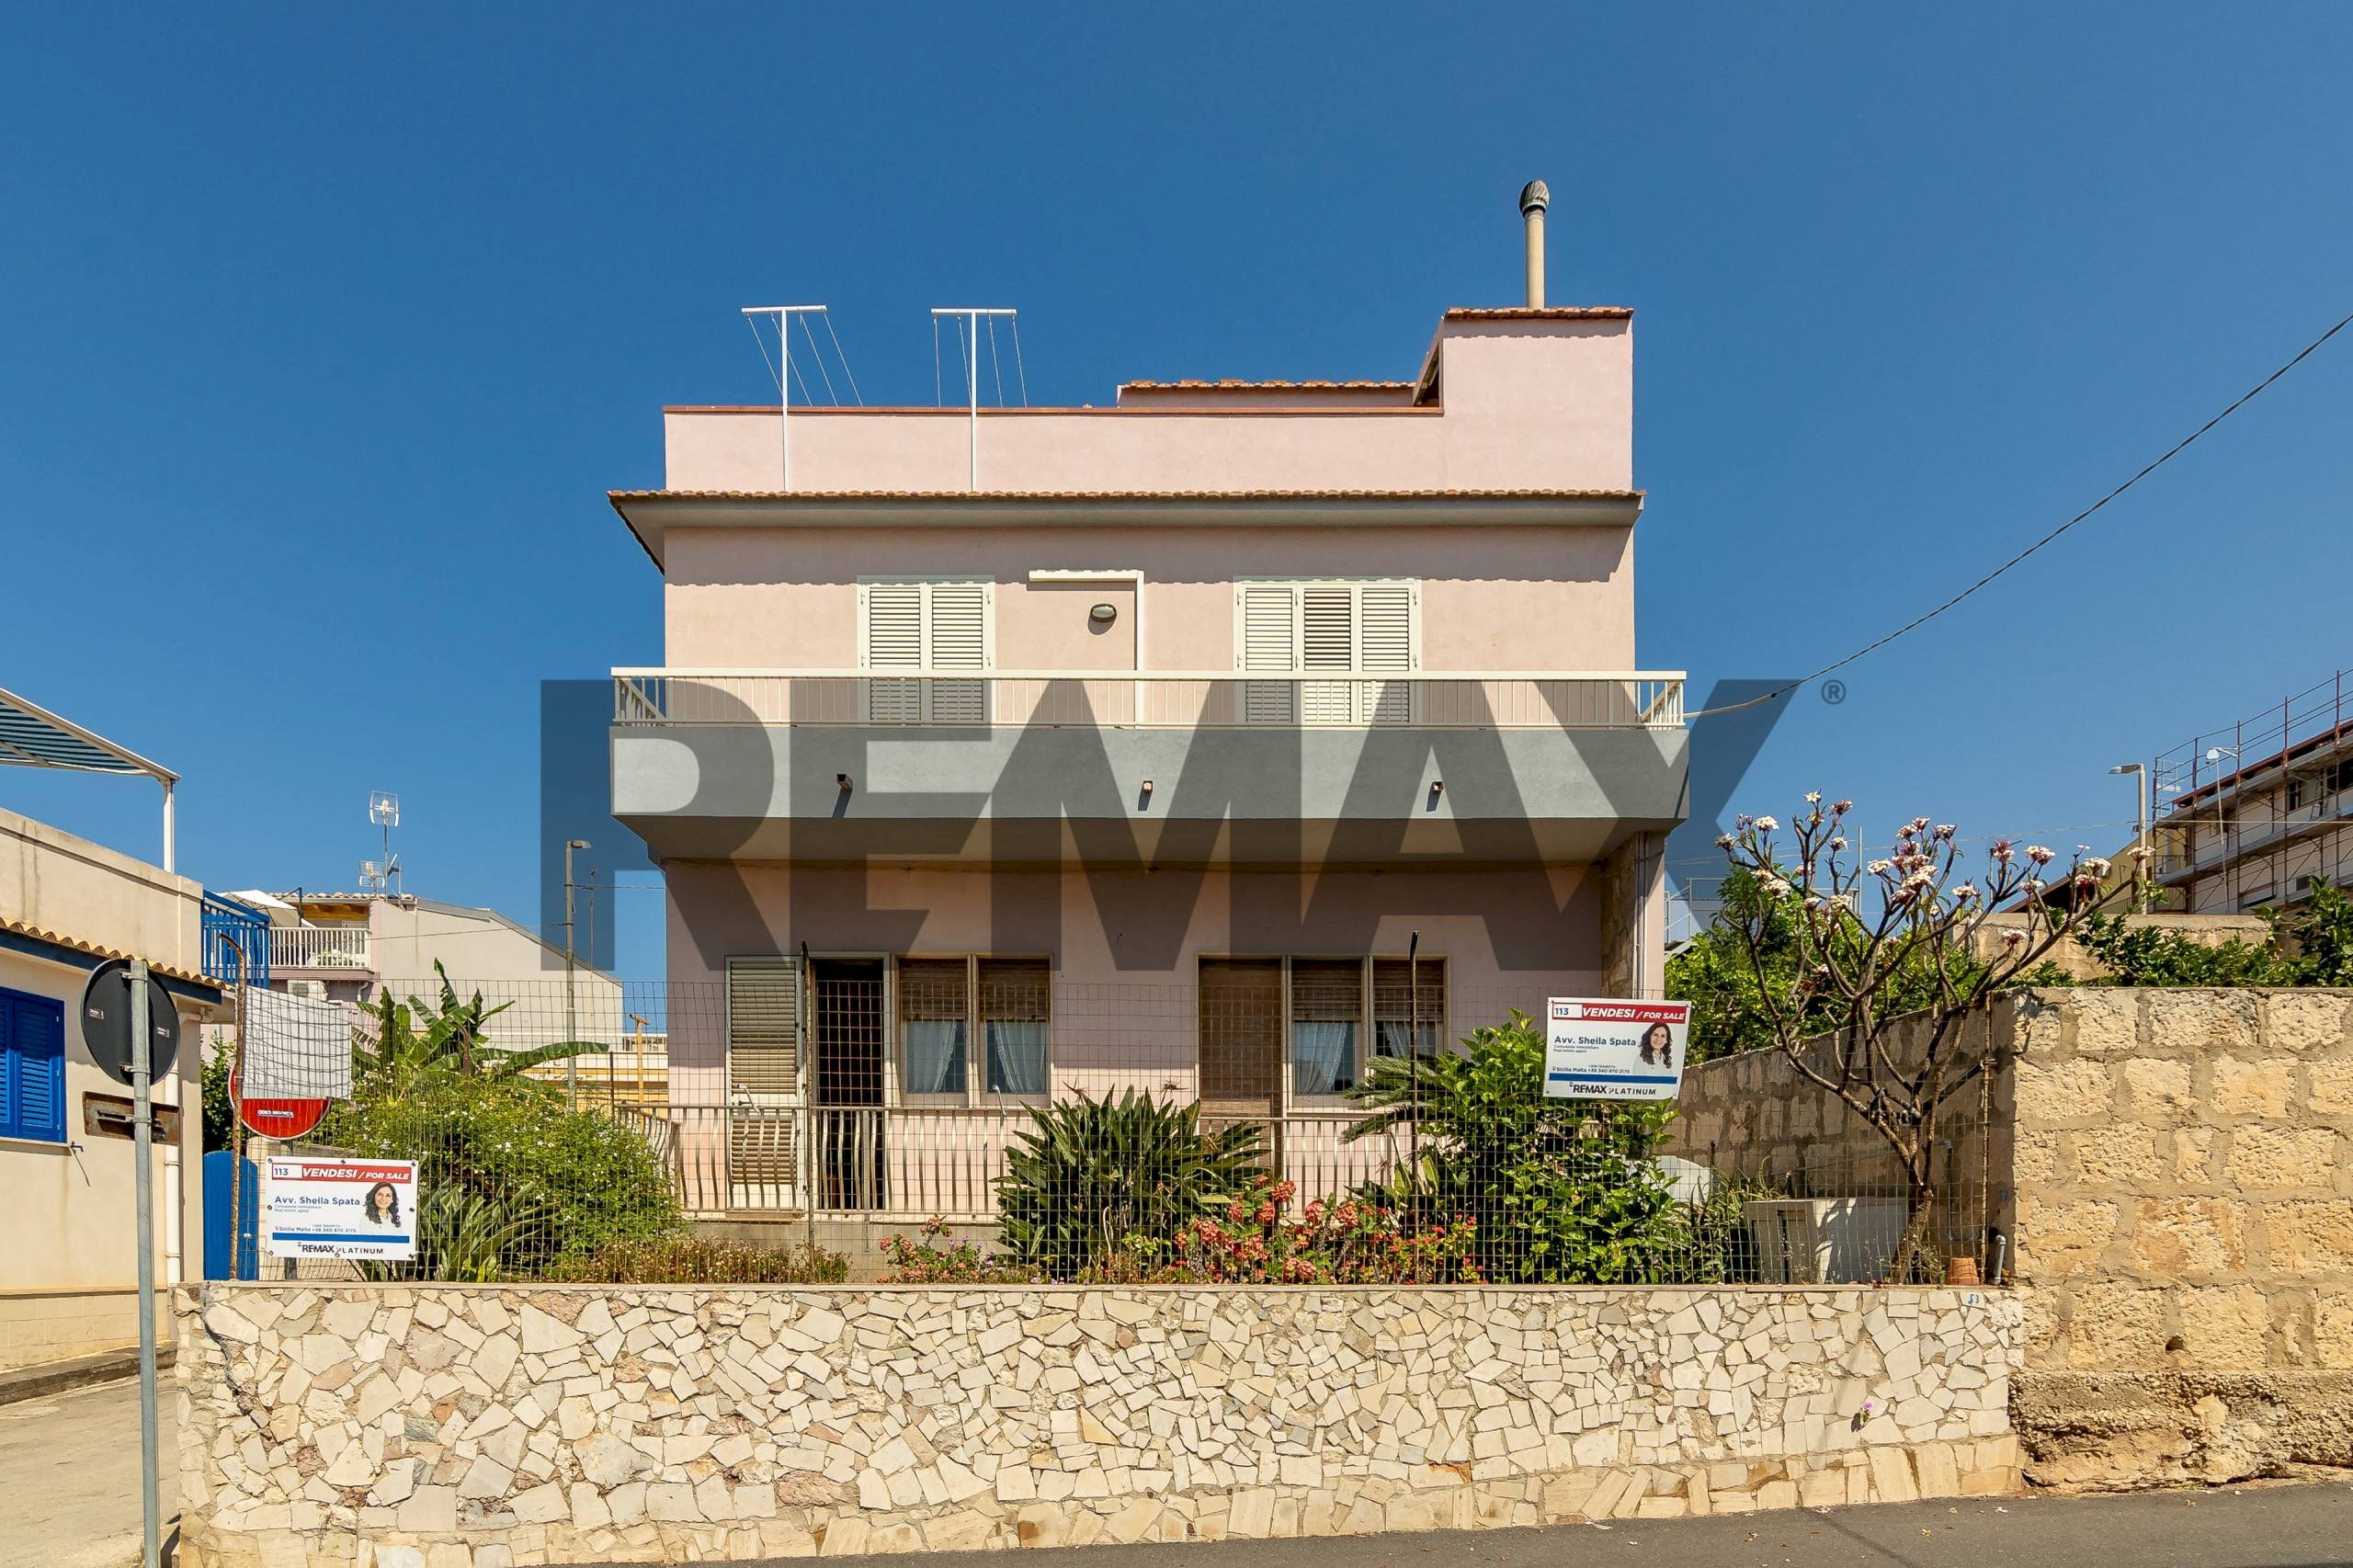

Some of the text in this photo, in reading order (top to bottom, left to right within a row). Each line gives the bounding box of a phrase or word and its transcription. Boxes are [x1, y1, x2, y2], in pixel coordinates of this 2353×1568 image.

[1554, 1007, 1569, 1016] 113
[1583, 1007, 1636, 1018] VENDESI
[1636, 1011, 1643, 1019] /
[1663, 1012, 1686, 1020] SALE
[1554, 1036, 1636, 1047] Avv. Sheila Spata
[275, 1168, 289, 1176] 113
[302, 1168, 358, 1178] VENDESI
[275, 1196, 360, 1206] Avv. Sheila Spata
